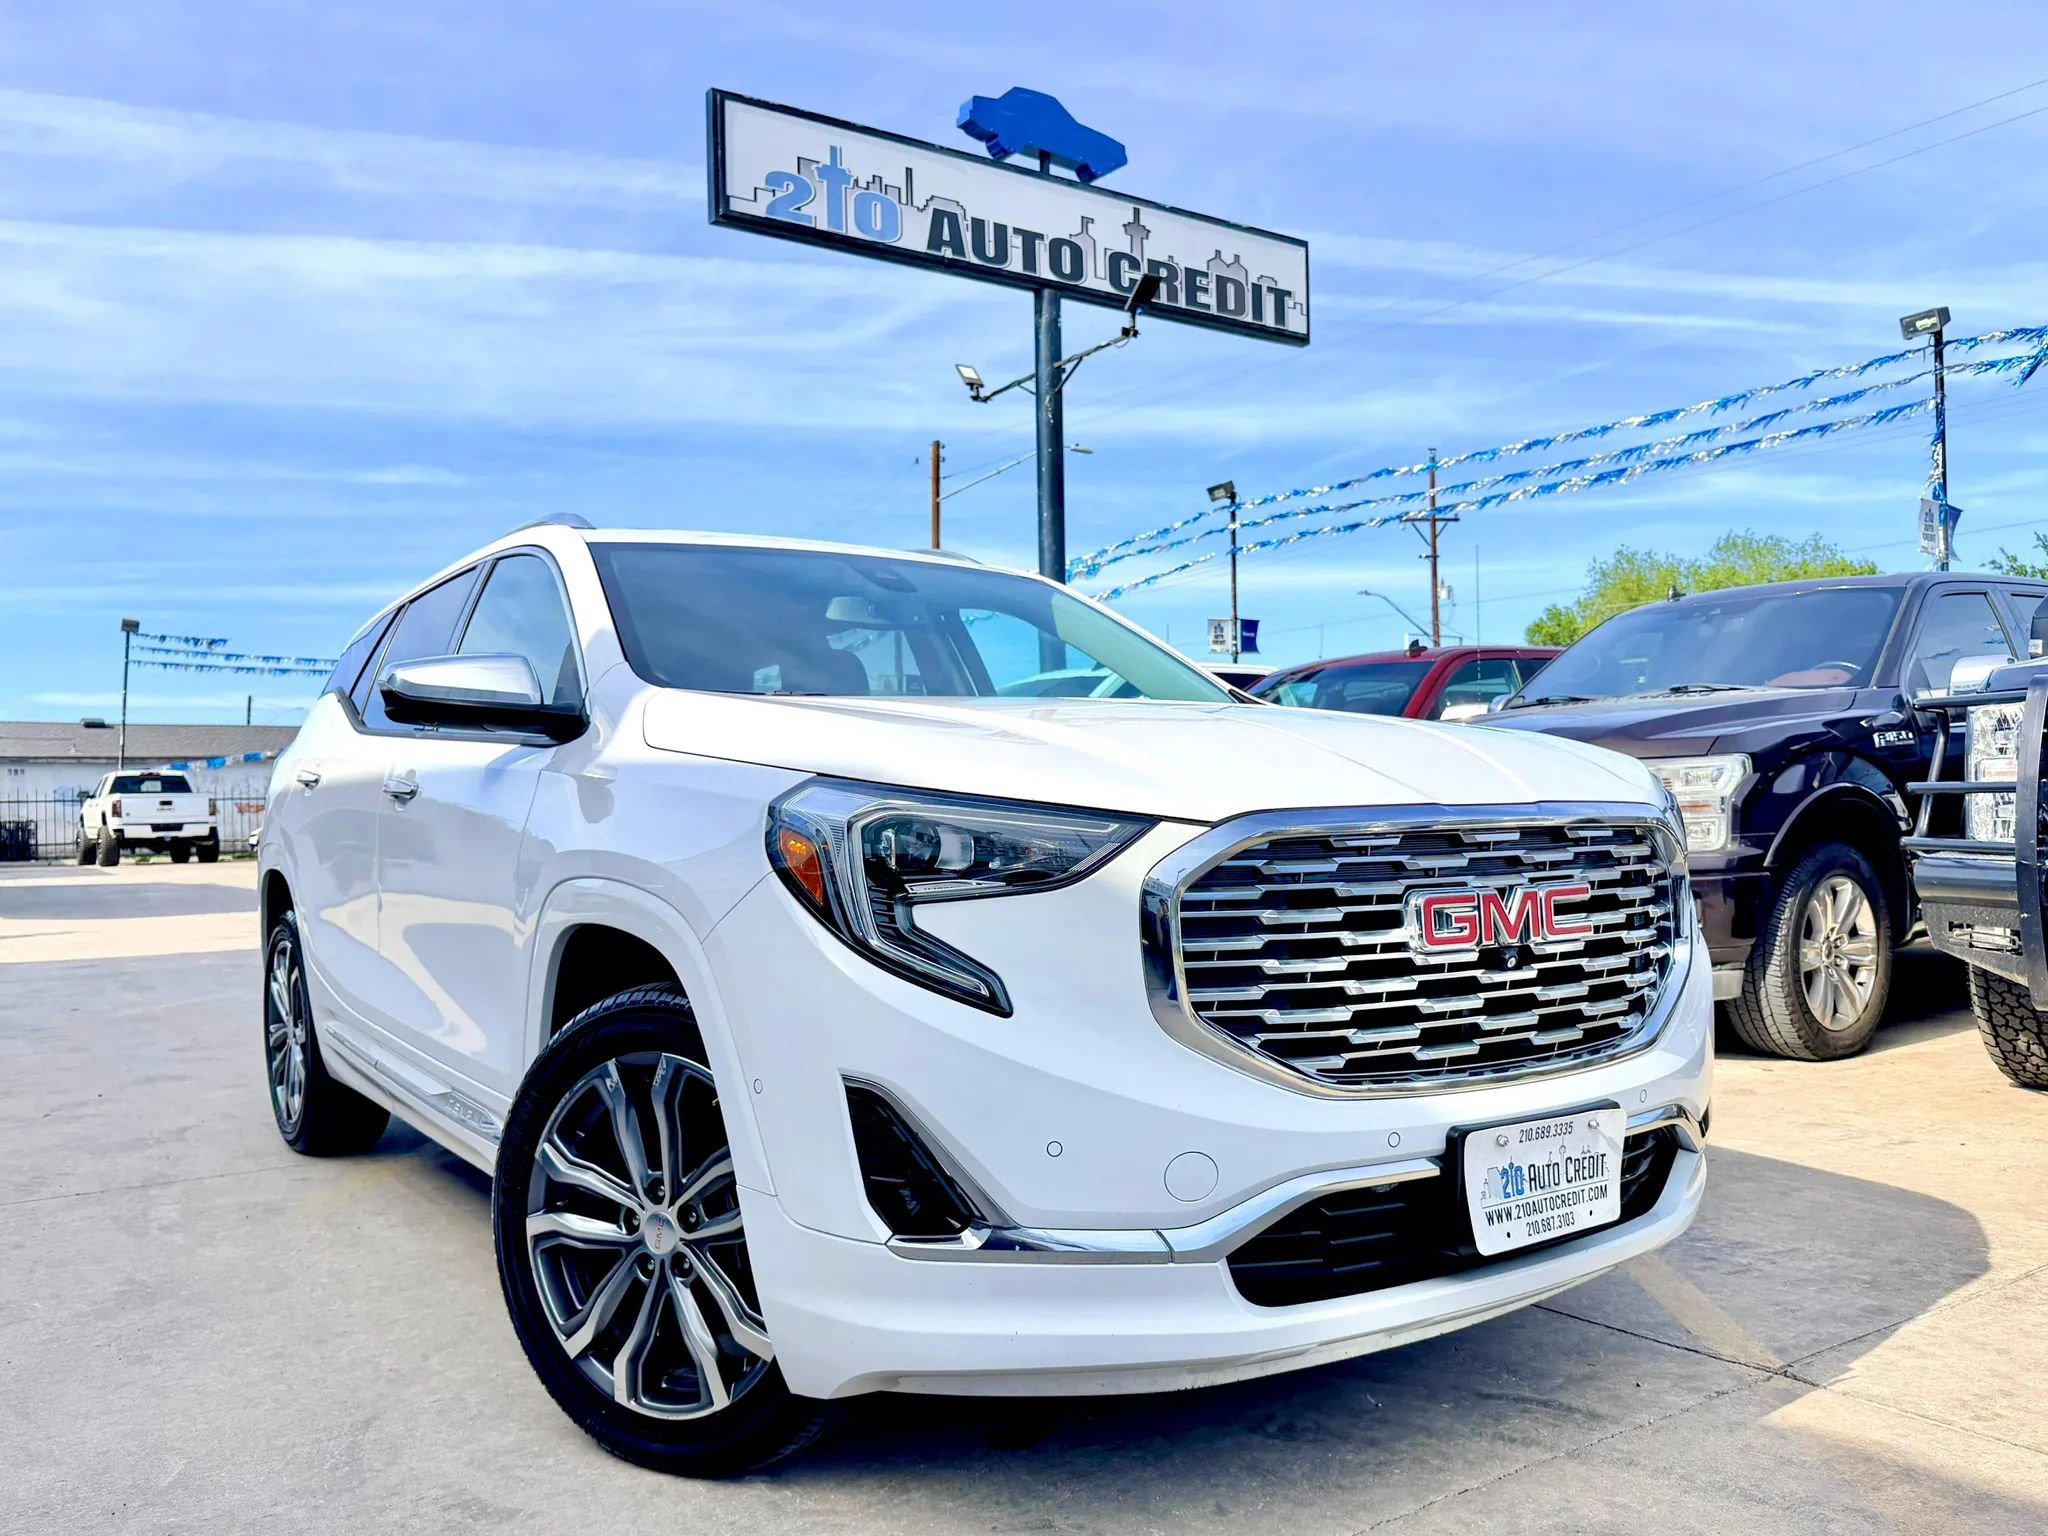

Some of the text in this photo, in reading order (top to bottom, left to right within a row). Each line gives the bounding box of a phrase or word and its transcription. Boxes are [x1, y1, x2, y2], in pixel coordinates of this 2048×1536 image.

[763, 145, 1294, 328] 210 AUTO CREDIT
[1406, 882, 1594, 953] GMC
[1519, 1122, 1573, 1143] 210.689.3335
[1500, 1152, 1607, 1199] 210 AUTO CREDIT
[1485, 1184, 1607, 1226] WWW.210AUTOCREDIT.COM
[1526, 1212, 1575, 1237] 210.687.3103
